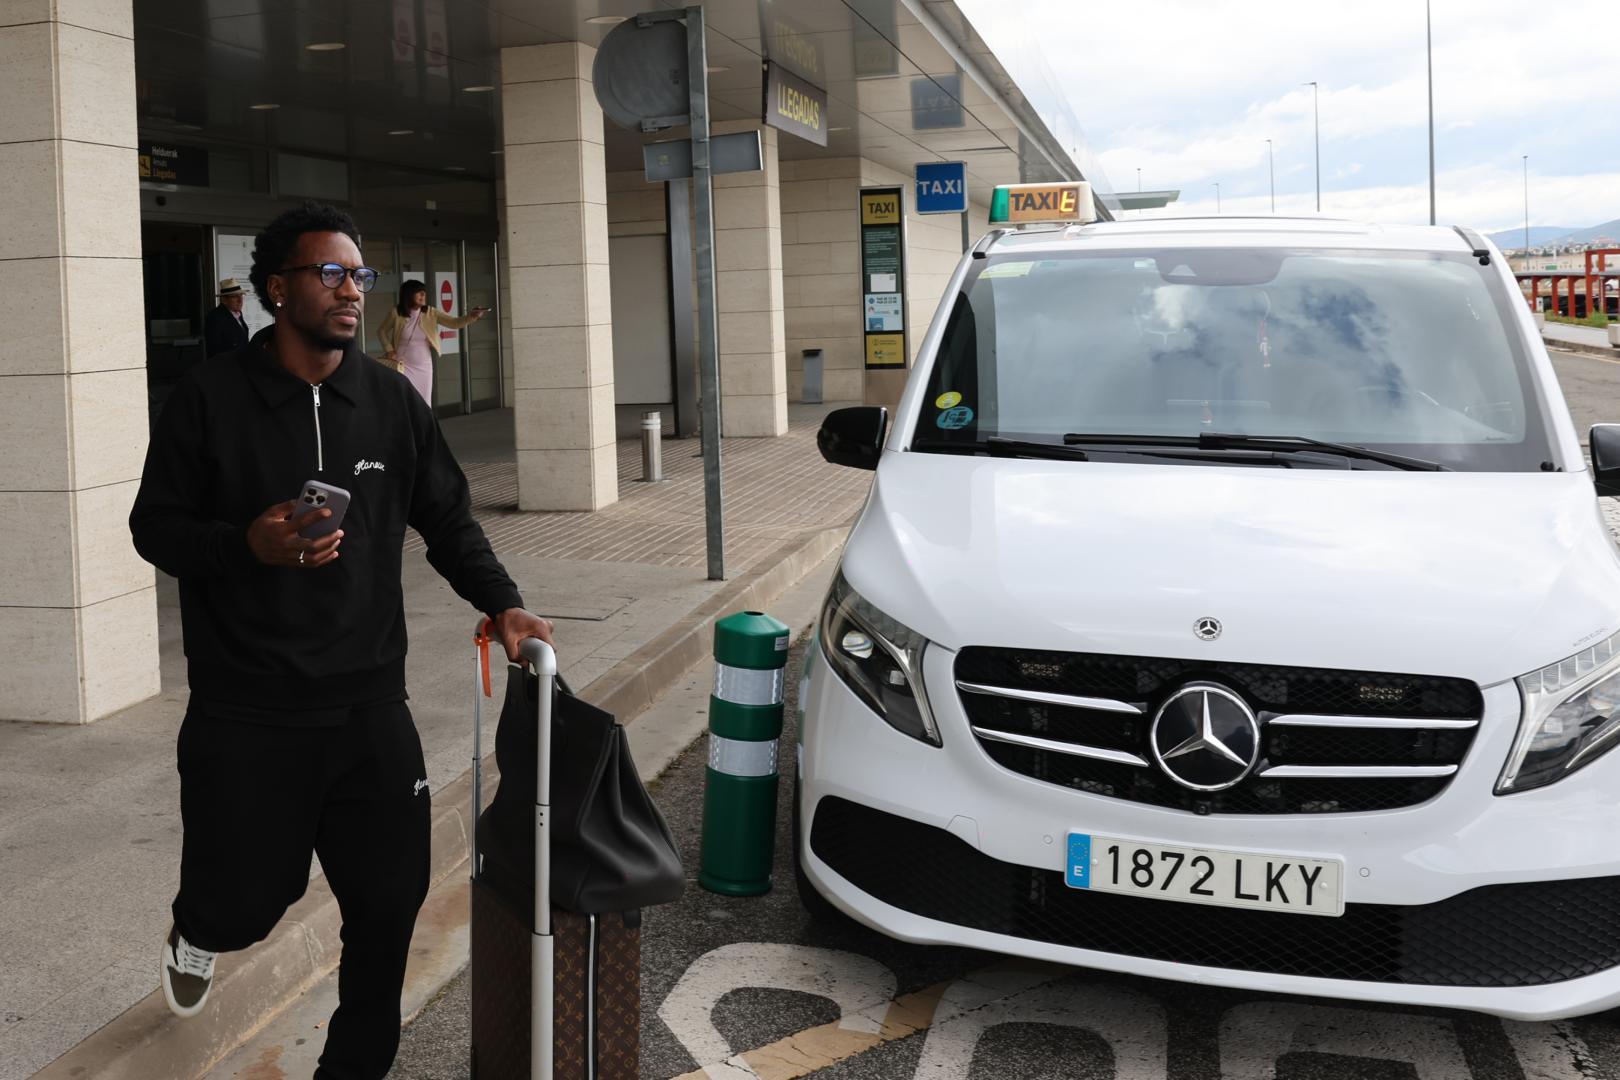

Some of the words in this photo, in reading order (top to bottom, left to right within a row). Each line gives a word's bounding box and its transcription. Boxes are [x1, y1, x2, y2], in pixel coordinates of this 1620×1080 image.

[777, 82, 819, 130] LLEGADAS
[918, 179, 962, 196] TAXI
[867, 202, 895, 214] TAXI
[1010, 191, 1059, 211] TAXI
[1073, 865, 1083, 877] E
[1107, 845, 1215, 896] 1872
[1234, 858, 1322, 906] LKY
